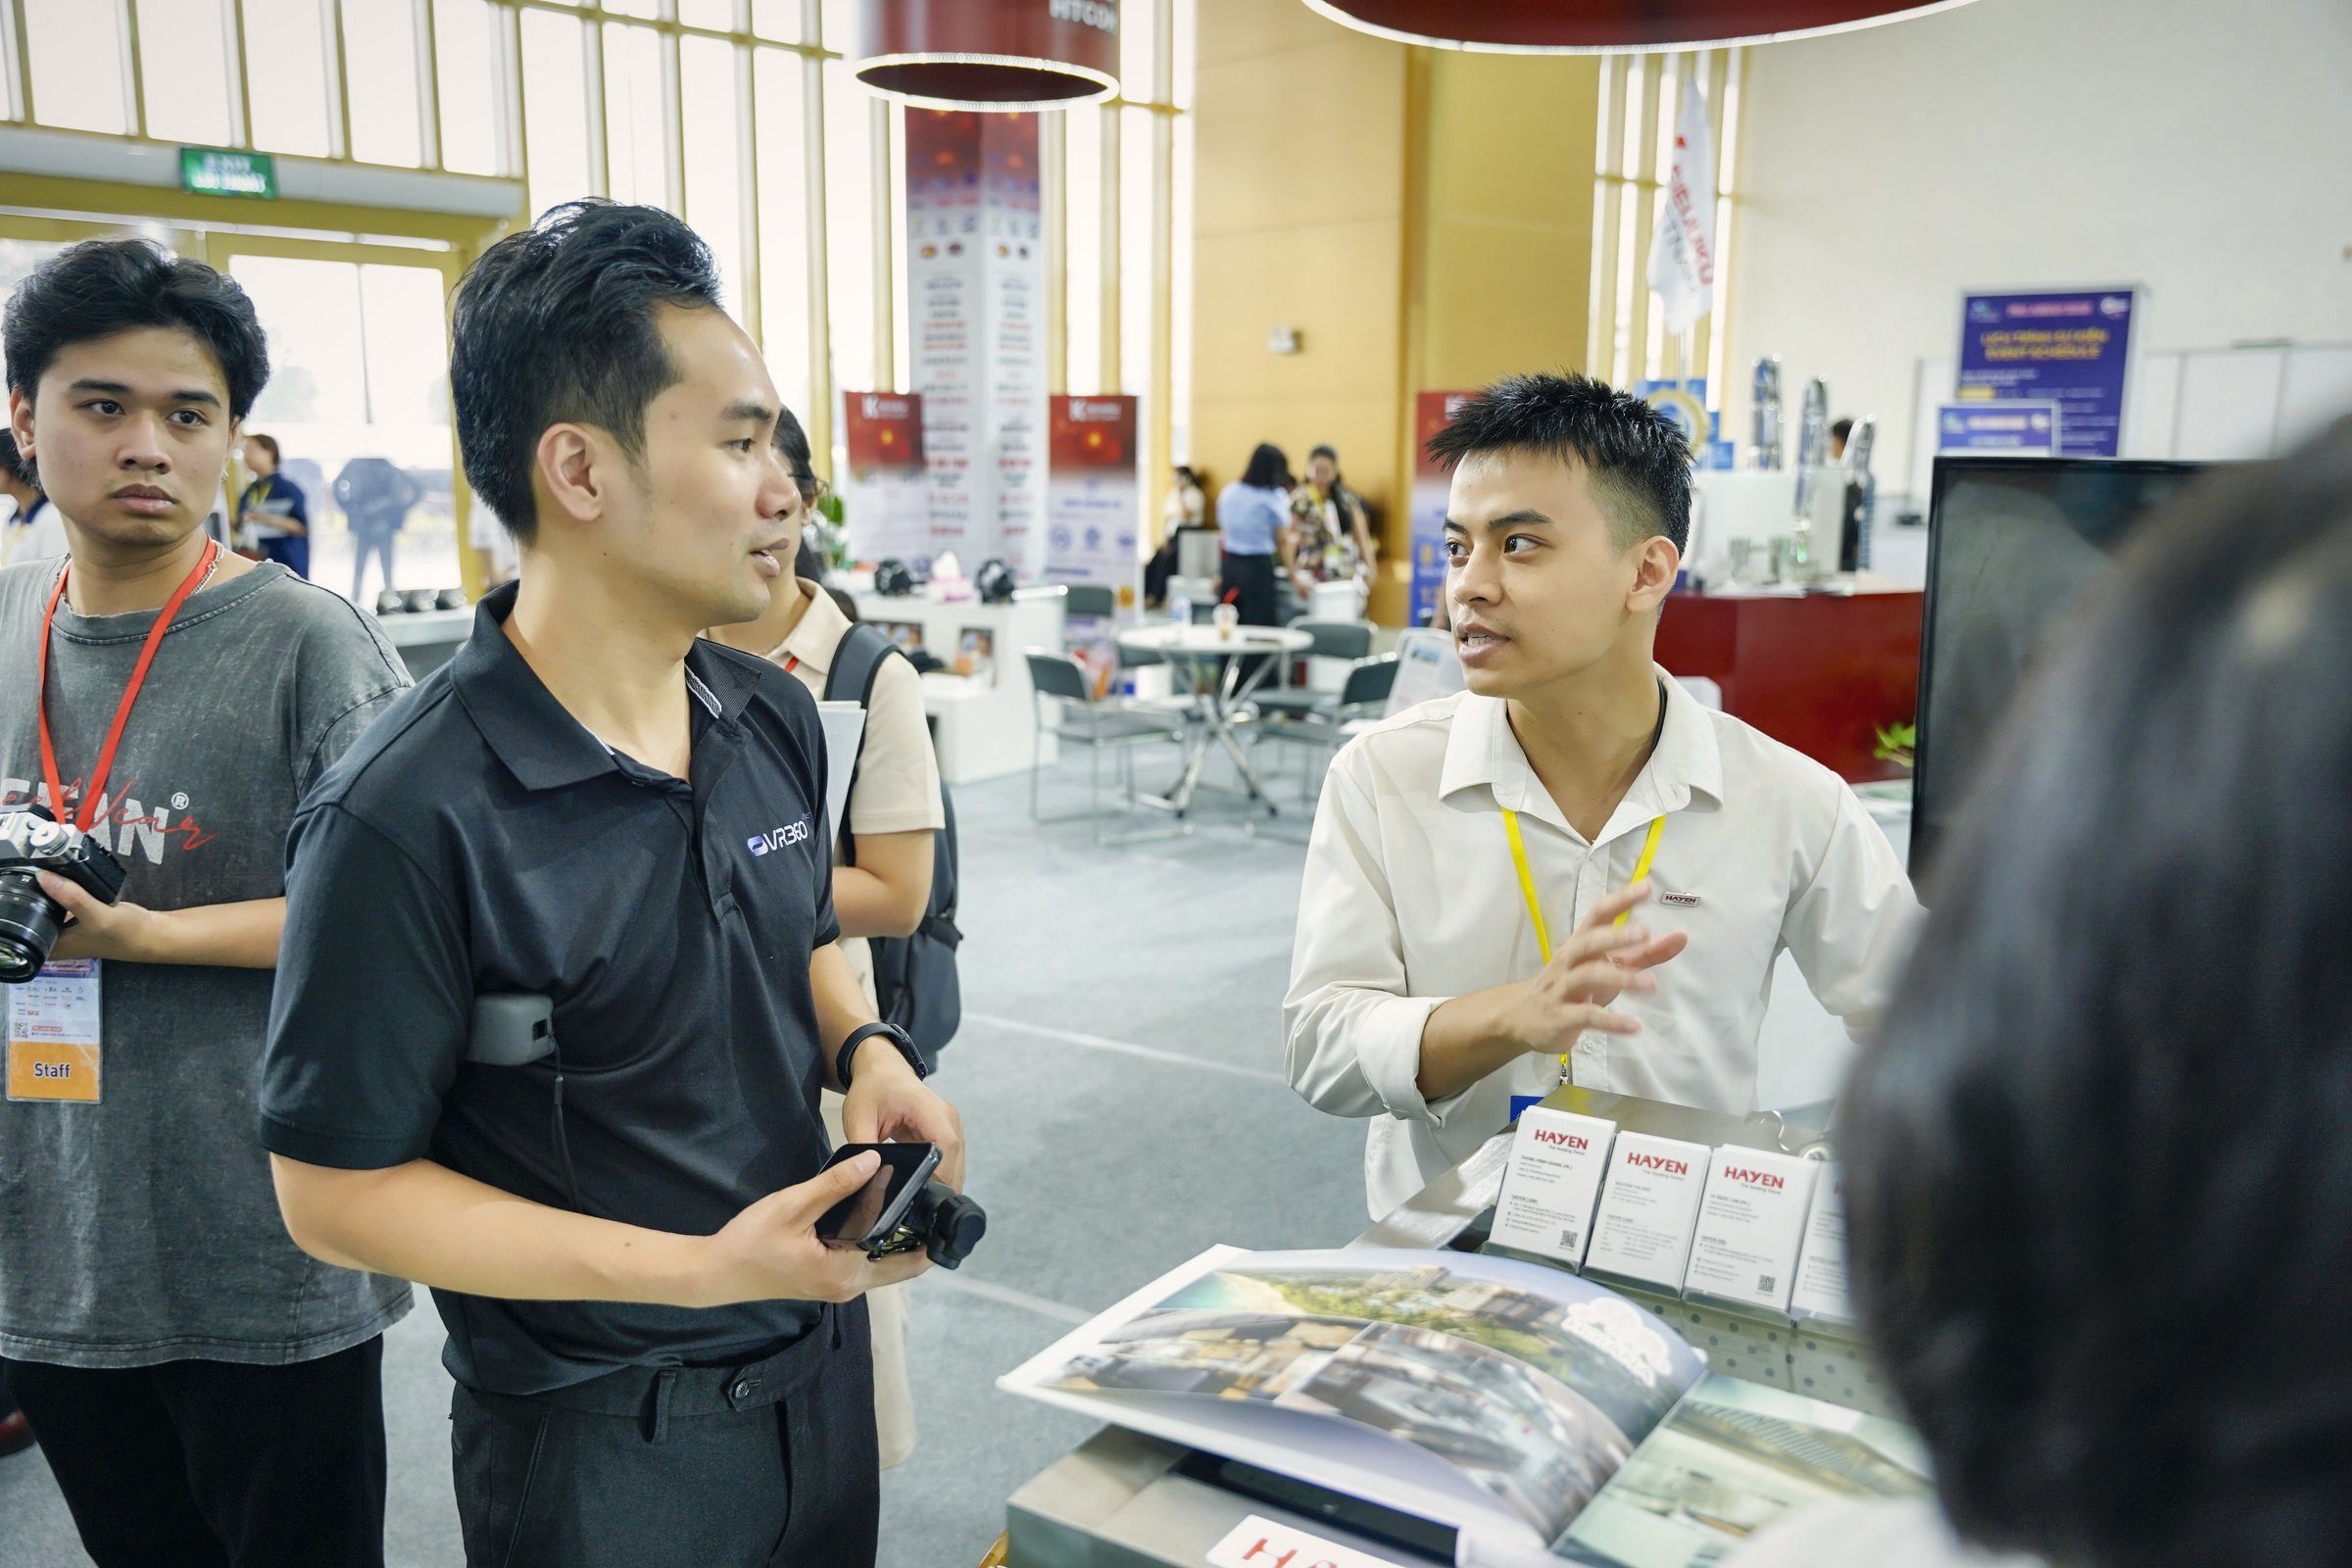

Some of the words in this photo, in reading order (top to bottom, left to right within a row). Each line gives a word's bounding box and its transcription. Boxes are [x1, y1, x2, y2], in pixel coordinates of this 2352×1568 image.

[763, 820, 808, 851] VR360
[1665, 895, 1696, 904] HAYEN
[34, 1062, 71, 1078] Staff
[1534, 1129, 1589, 1151] HAYEN
[1627, 1152, 1688, 1175] HAYEN
[1724, 1165, 1785, 1189] HAYEN
